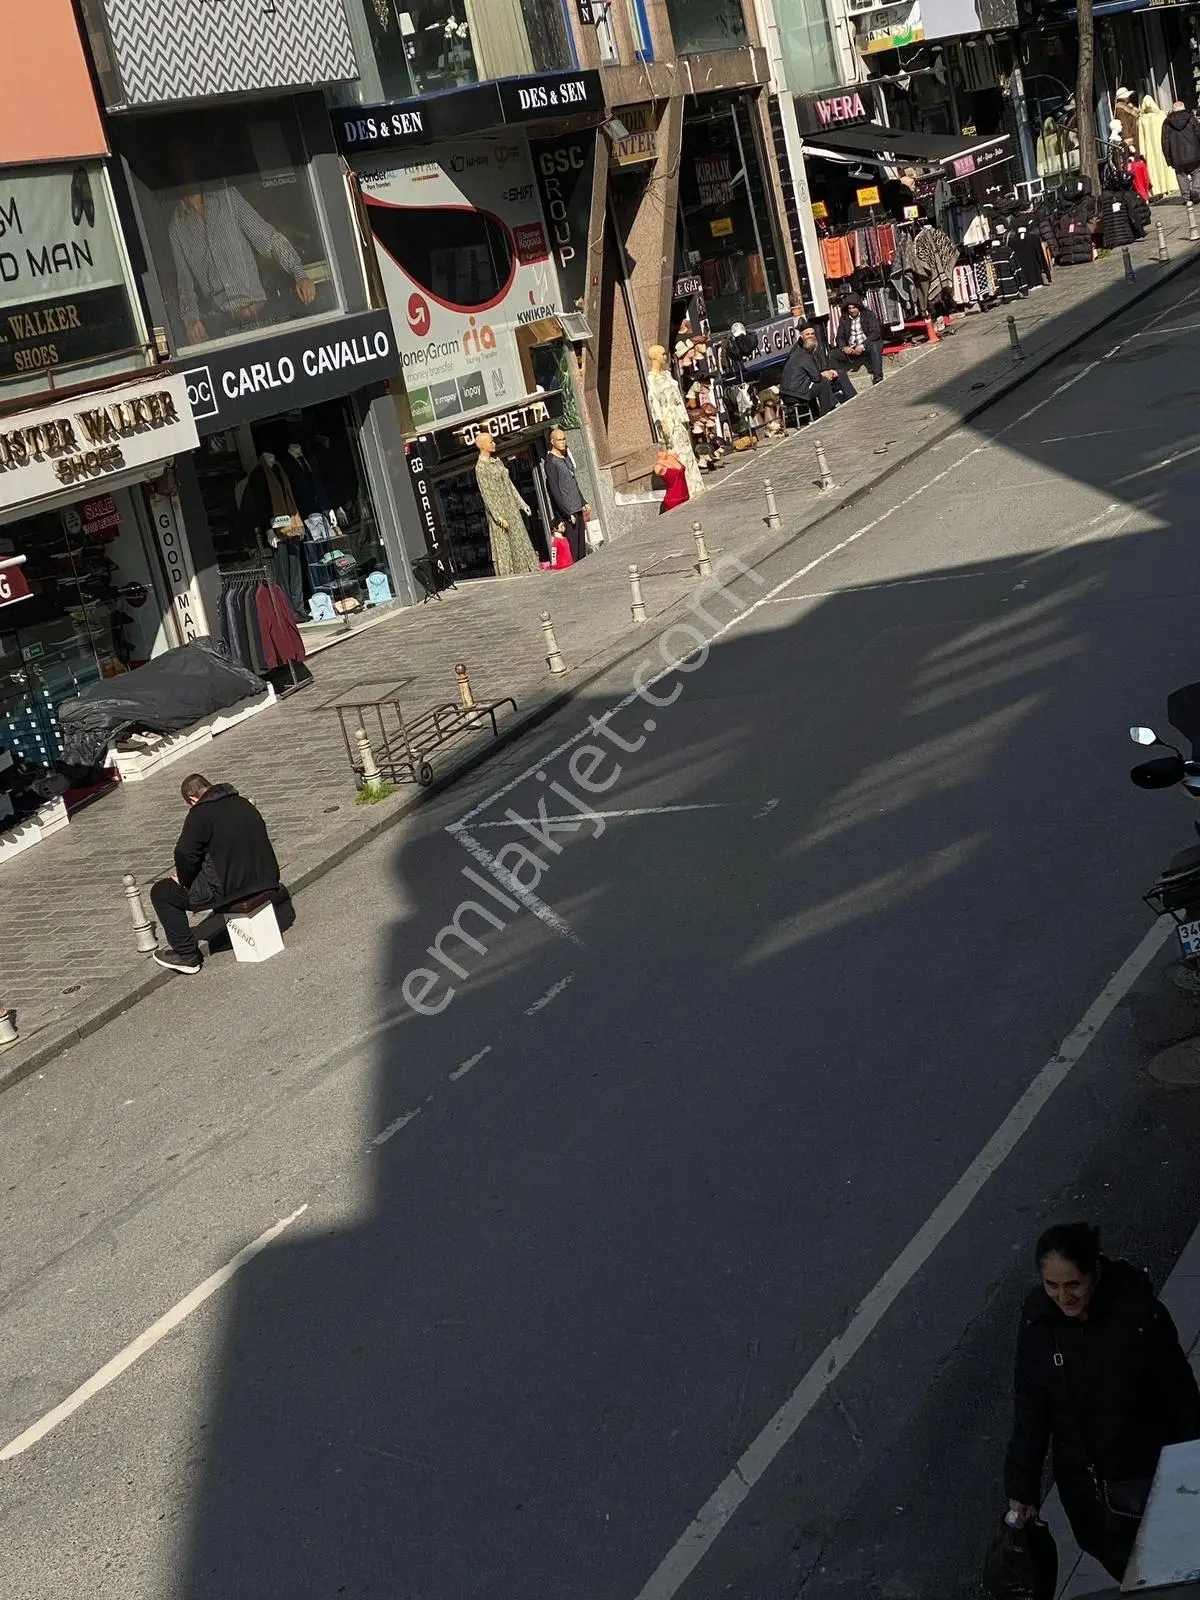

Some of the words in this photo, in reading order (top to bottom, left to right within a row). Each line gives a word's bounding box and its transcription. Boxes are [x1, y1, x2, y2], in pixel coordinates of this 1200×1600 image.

[519, 86, 548, 109] DES
[550, 91, 558, 104] &
[560, 81, 587, 103] SEN
[814, 92, 866, 125] WERA
[344, 117, 377, 142] DES
[381, 121, 389, 136] &
[391, 111, 424, 136] SEN
[540, 145, 584, 175] GSC
[26, 238, 94, 278] MAN
[8, 303, 81, 340] WALKER
[516, 303, 556, 325] KWIKPAY
[463, 316, 497, 357] ria
[763, 334, 771, 354] &
[773, 326, 796, 351] GAP
[14, 344, 59, 370] SHOES
[222, 356, 295, 398] CARLO
[302, 331, 389, 377] CAVALLO
[407, 370, 429, 384] money
[429, 360, 454, 376] transfer
[74, 391, 179, 447] WALKER
[488, 401, 551, 438] GRETTA
[53, 444, 124, 479] SHOES
[84, 498, 115, 520] SALE
[158, 513, 182, 583] GOOD
[178, 593, 198, 642] MAN
